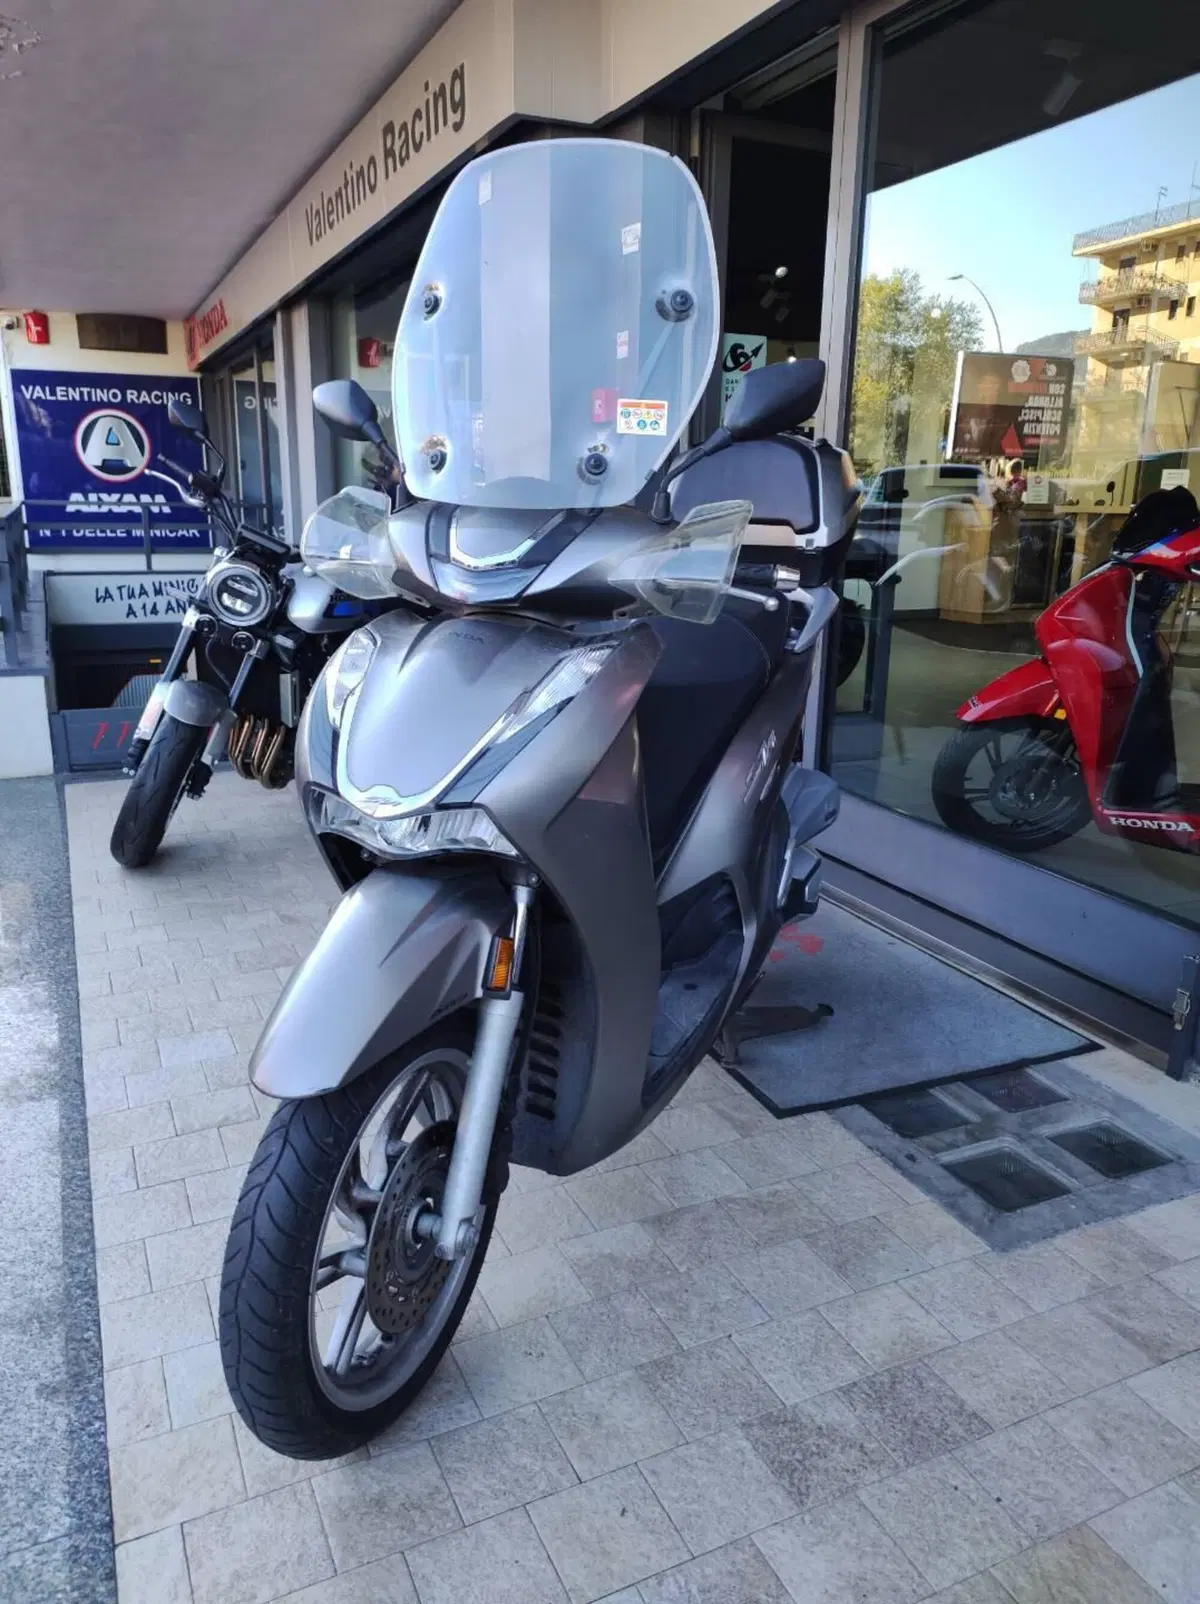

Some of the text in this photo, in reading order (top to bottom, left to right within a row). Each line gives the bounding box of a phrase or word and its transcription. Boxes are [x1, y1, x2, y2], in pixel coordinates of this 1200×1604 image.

[305, 62, 467, 247] Valentino Racing
[20, 384, 192, 406] VALENTINO RACING
[65, 492, 172, 514] AIXAM
[131, 526, 200, 538] MNICAR
[95, 586, 115, 604] LA
[116, 583, 149, 601] TUA
[126, 603, 138, 619] A
[1108, 816, 1195, 832] HONDA
